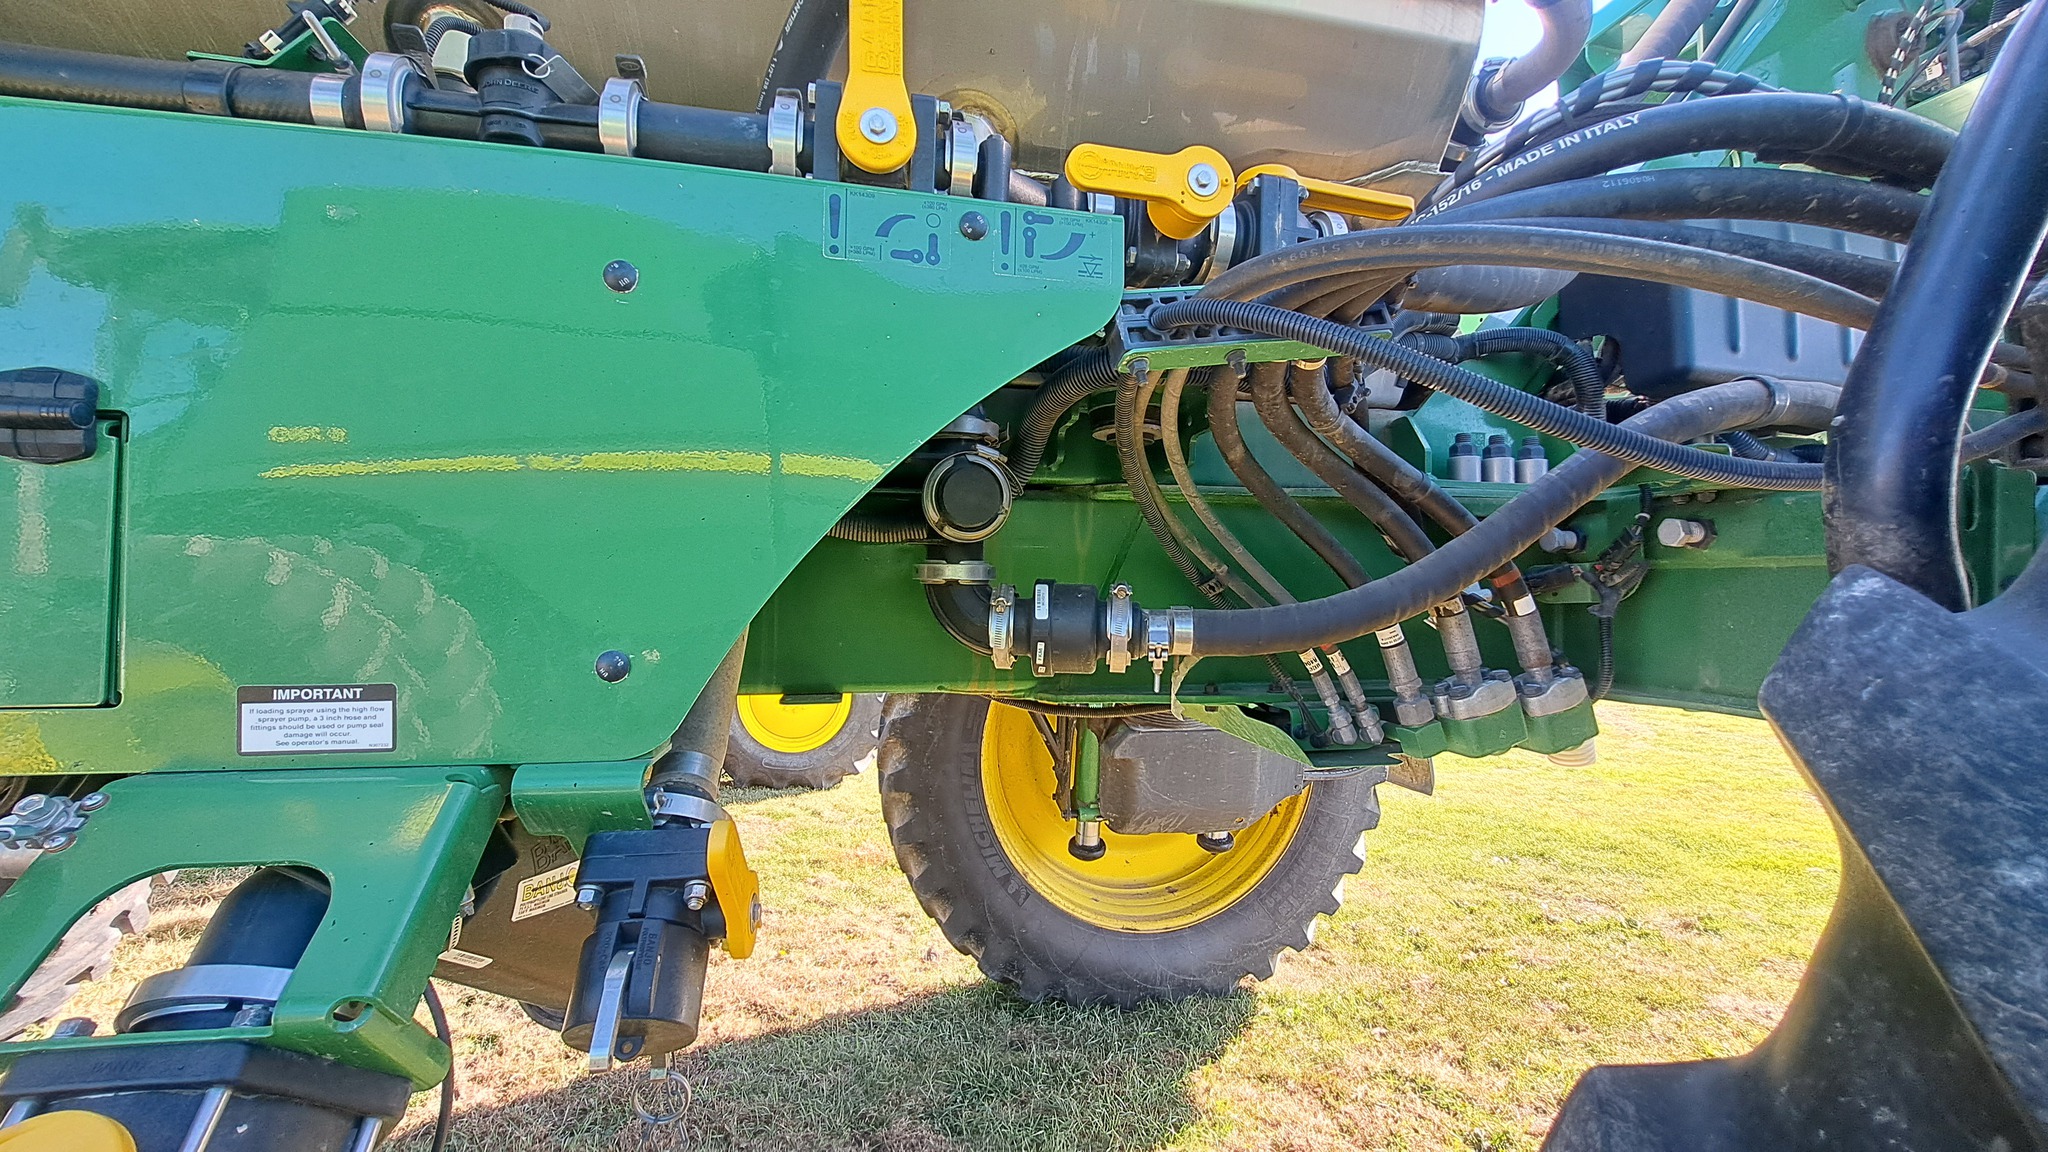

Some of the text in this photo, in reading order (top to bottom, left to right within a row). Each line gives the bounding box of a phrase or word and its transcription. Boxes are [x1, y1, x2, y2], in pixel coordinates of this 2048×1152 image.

[1496, 143, 1556, 178] MADE
[1557, 133, 1581, 150] IN
[1584, 113, 1642, 141] ITALY
[272, 688, 364, 700] IMPORTANT
[352, 706, 368, 714] high
[291, 739, 329, 747] operator's
[960, 754, 1011, 879] MICHELIN
[643, 932, 658, 966] BANJO
